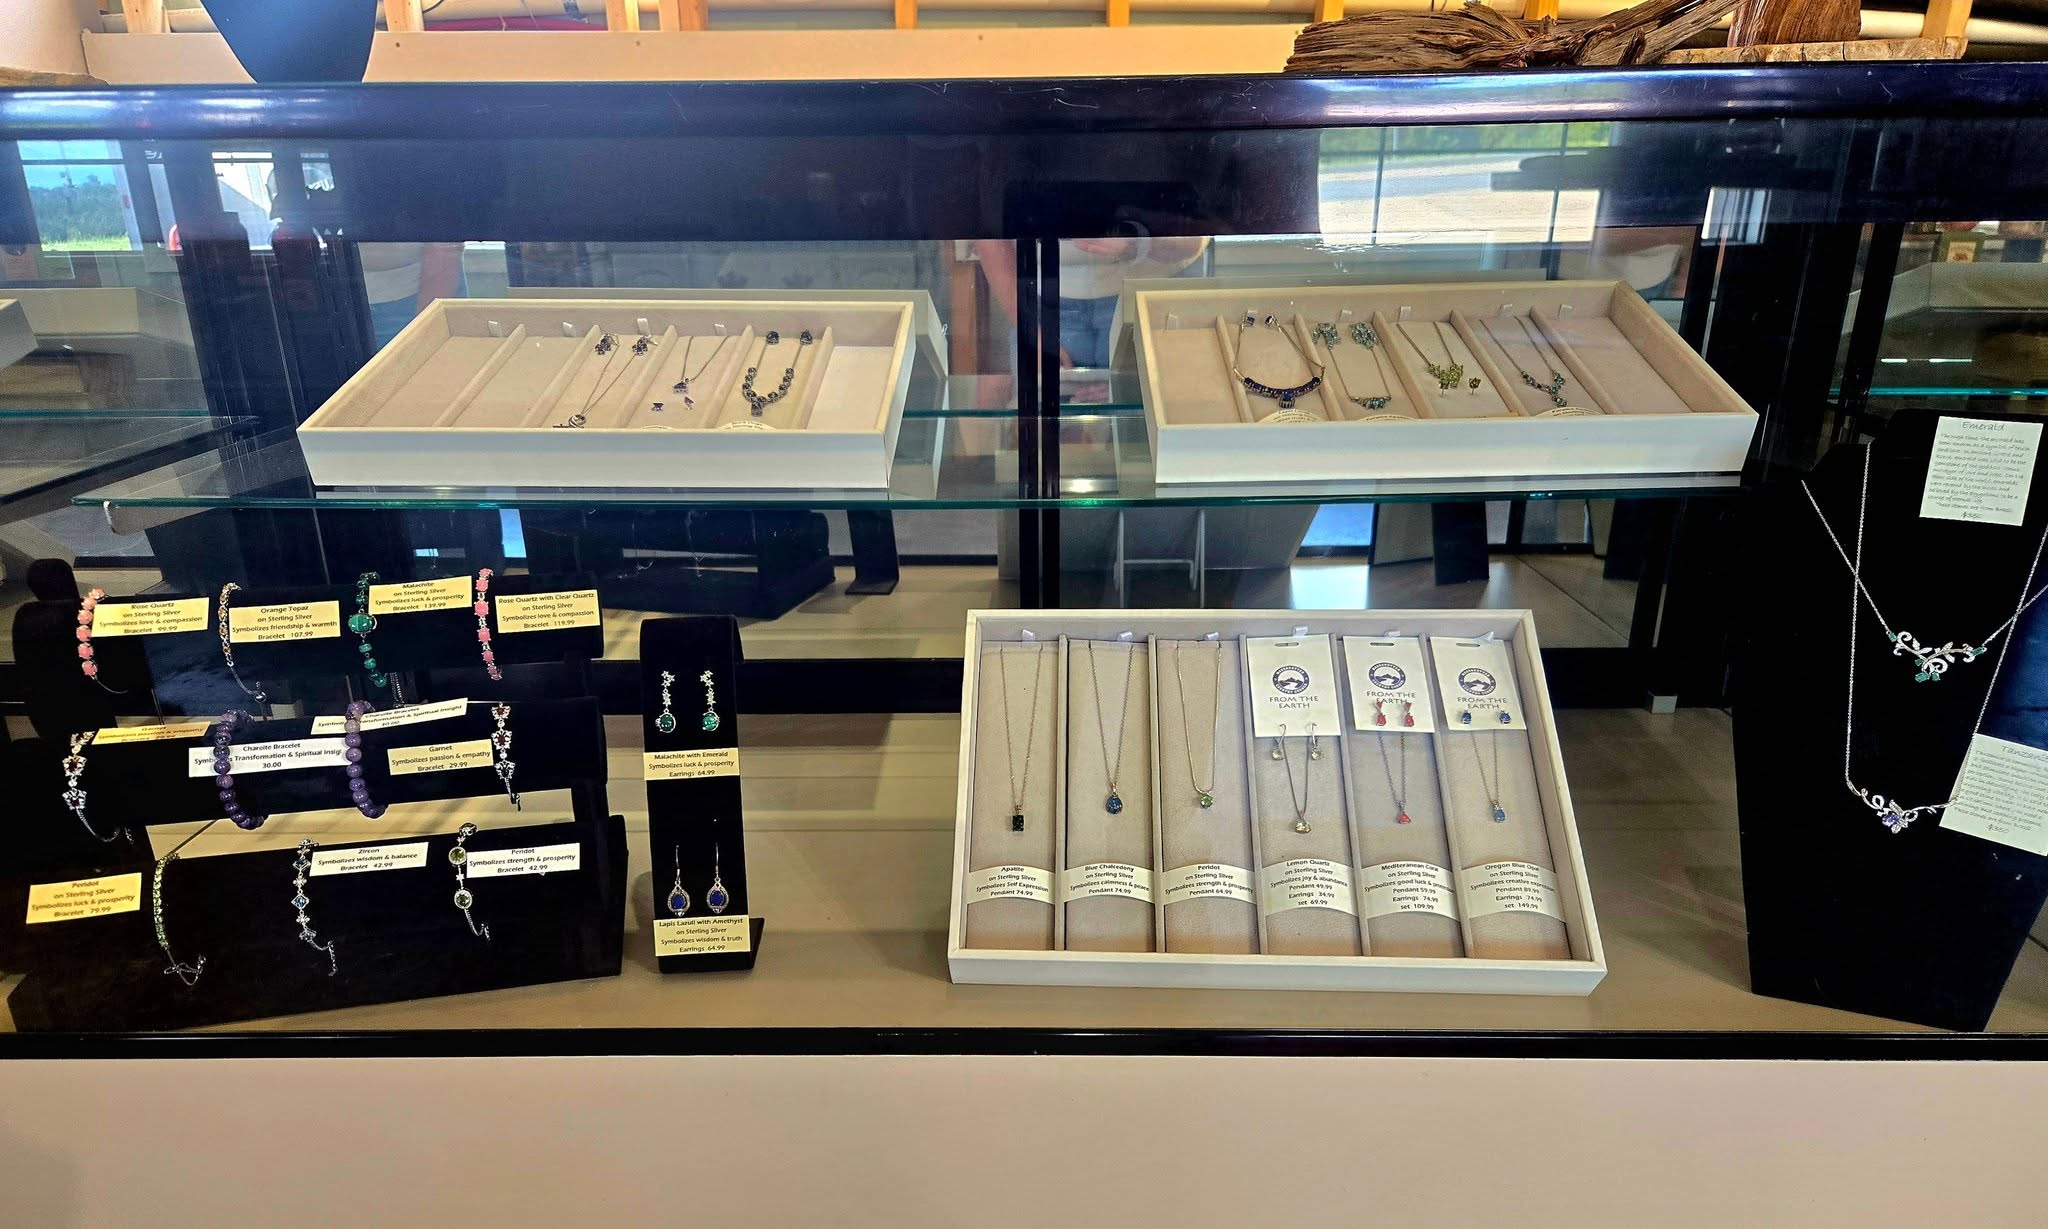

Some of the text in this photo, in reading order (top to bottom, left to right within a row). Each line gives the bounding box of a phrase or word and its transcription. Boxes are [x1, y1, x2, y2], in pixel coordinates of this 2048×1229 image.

[1962, 422, 2005, 431] Emerald
[502, 614, 536, 622] Symbolizes
[558, 610, 594, 618] compassion
[232, 626, 269, 634] Symbolizes
[270, 623, 303, 631] friendship
[243, 742, 301, 752] Charoite Bracelet
[235, 752, 286, 762] Transformation
[294, 749, 322, 759] Spiritual
[392, 757, 428, 766] Symbolizes
[429, 754, 454, 762] passion
[417, 764, 444, 772] Bracelet
[1286, 859, 1330, 867] Lemon Quartz
[1099, 864, 1135, 873] Chalcedony
[1021, 874, 1037, 882] Silver
[1270, 877, 1301, 888] Symbolizes
[976, 882, 1006, 892] Symbolizes
[1018, 882, 1049, 892] Expression
[1070, 881, 1100, 891] Symbolizes
[1134, 883, 1150, 892] peace
[1364, 881, 1396, 892] Symbolizes
[1470, 880, 1504, 891] Symbolizes
[1189, 888, 1215, 896] Pendant
